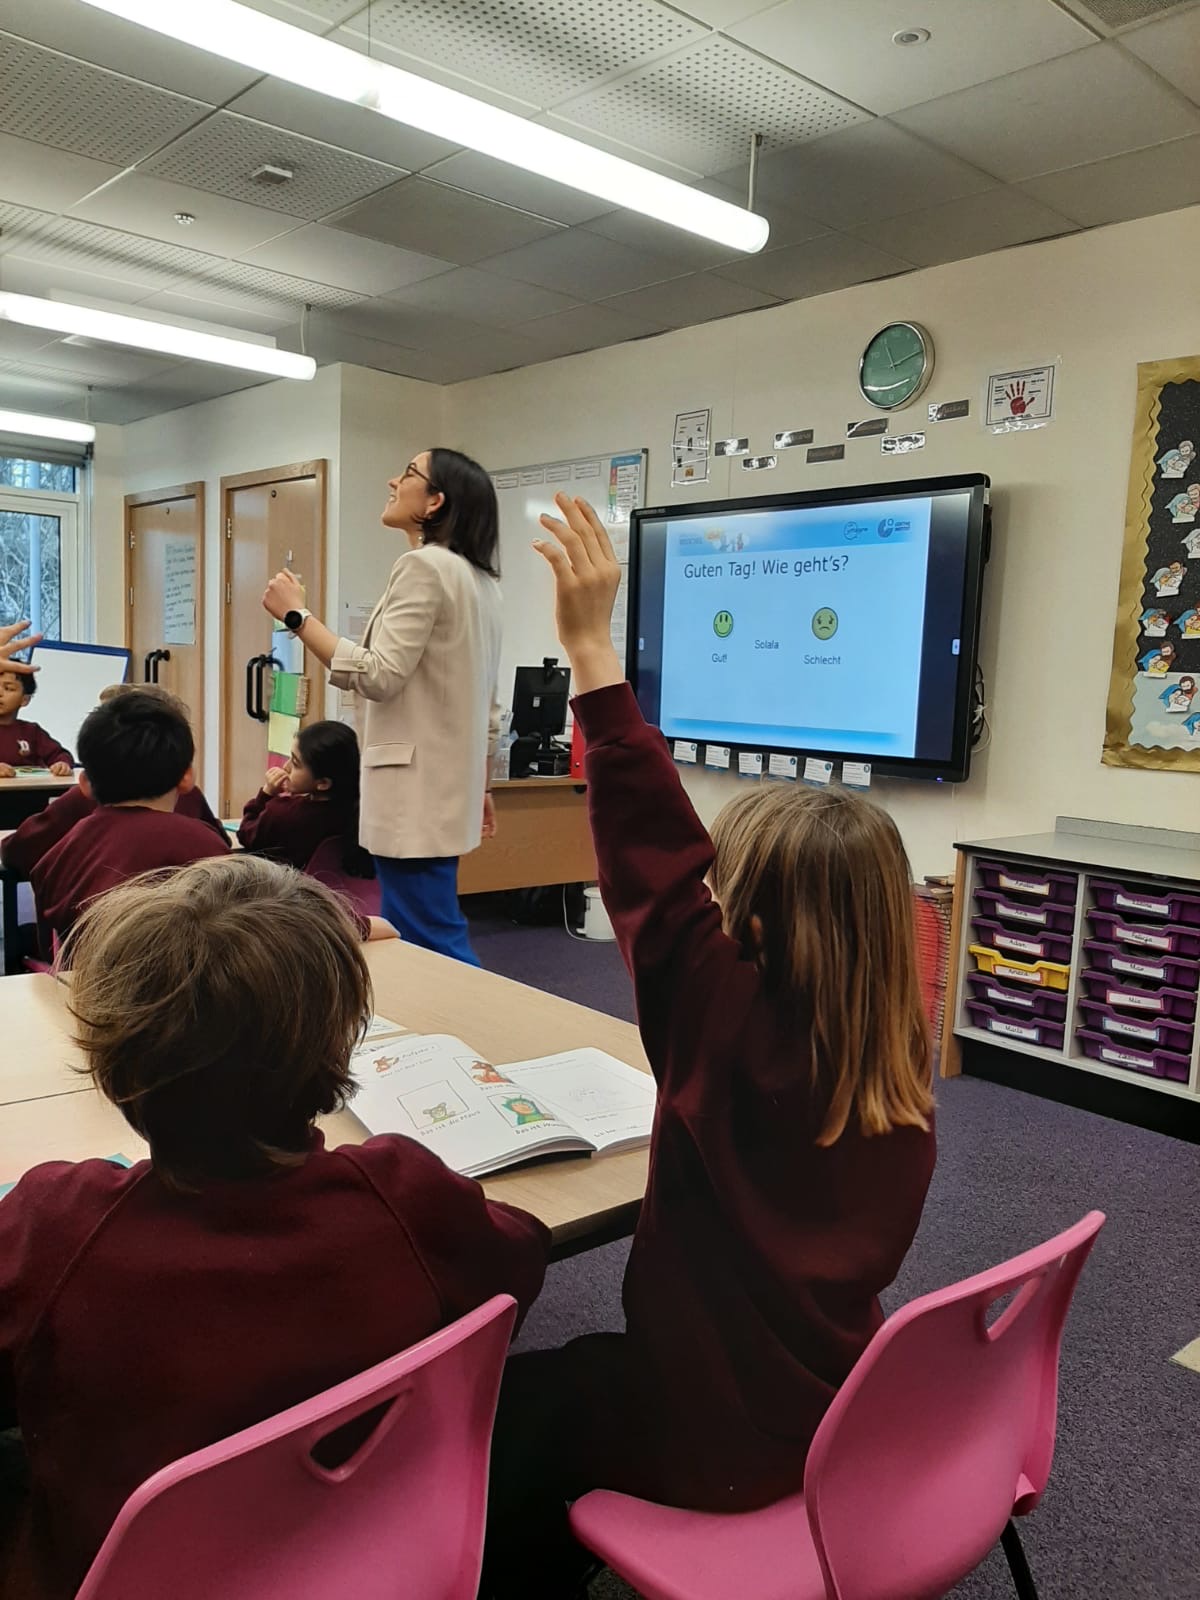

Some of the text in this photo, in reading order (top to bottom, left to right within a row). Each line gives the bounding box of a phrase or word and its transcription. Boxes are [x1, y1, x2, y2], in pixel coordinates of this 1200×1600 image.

[684, 563, 723, 578] Guten
[728, 560, 756, 579] Tag!
[762, 559, 788, 574] Wie
[803, 654, 841, 665] Schlecht
